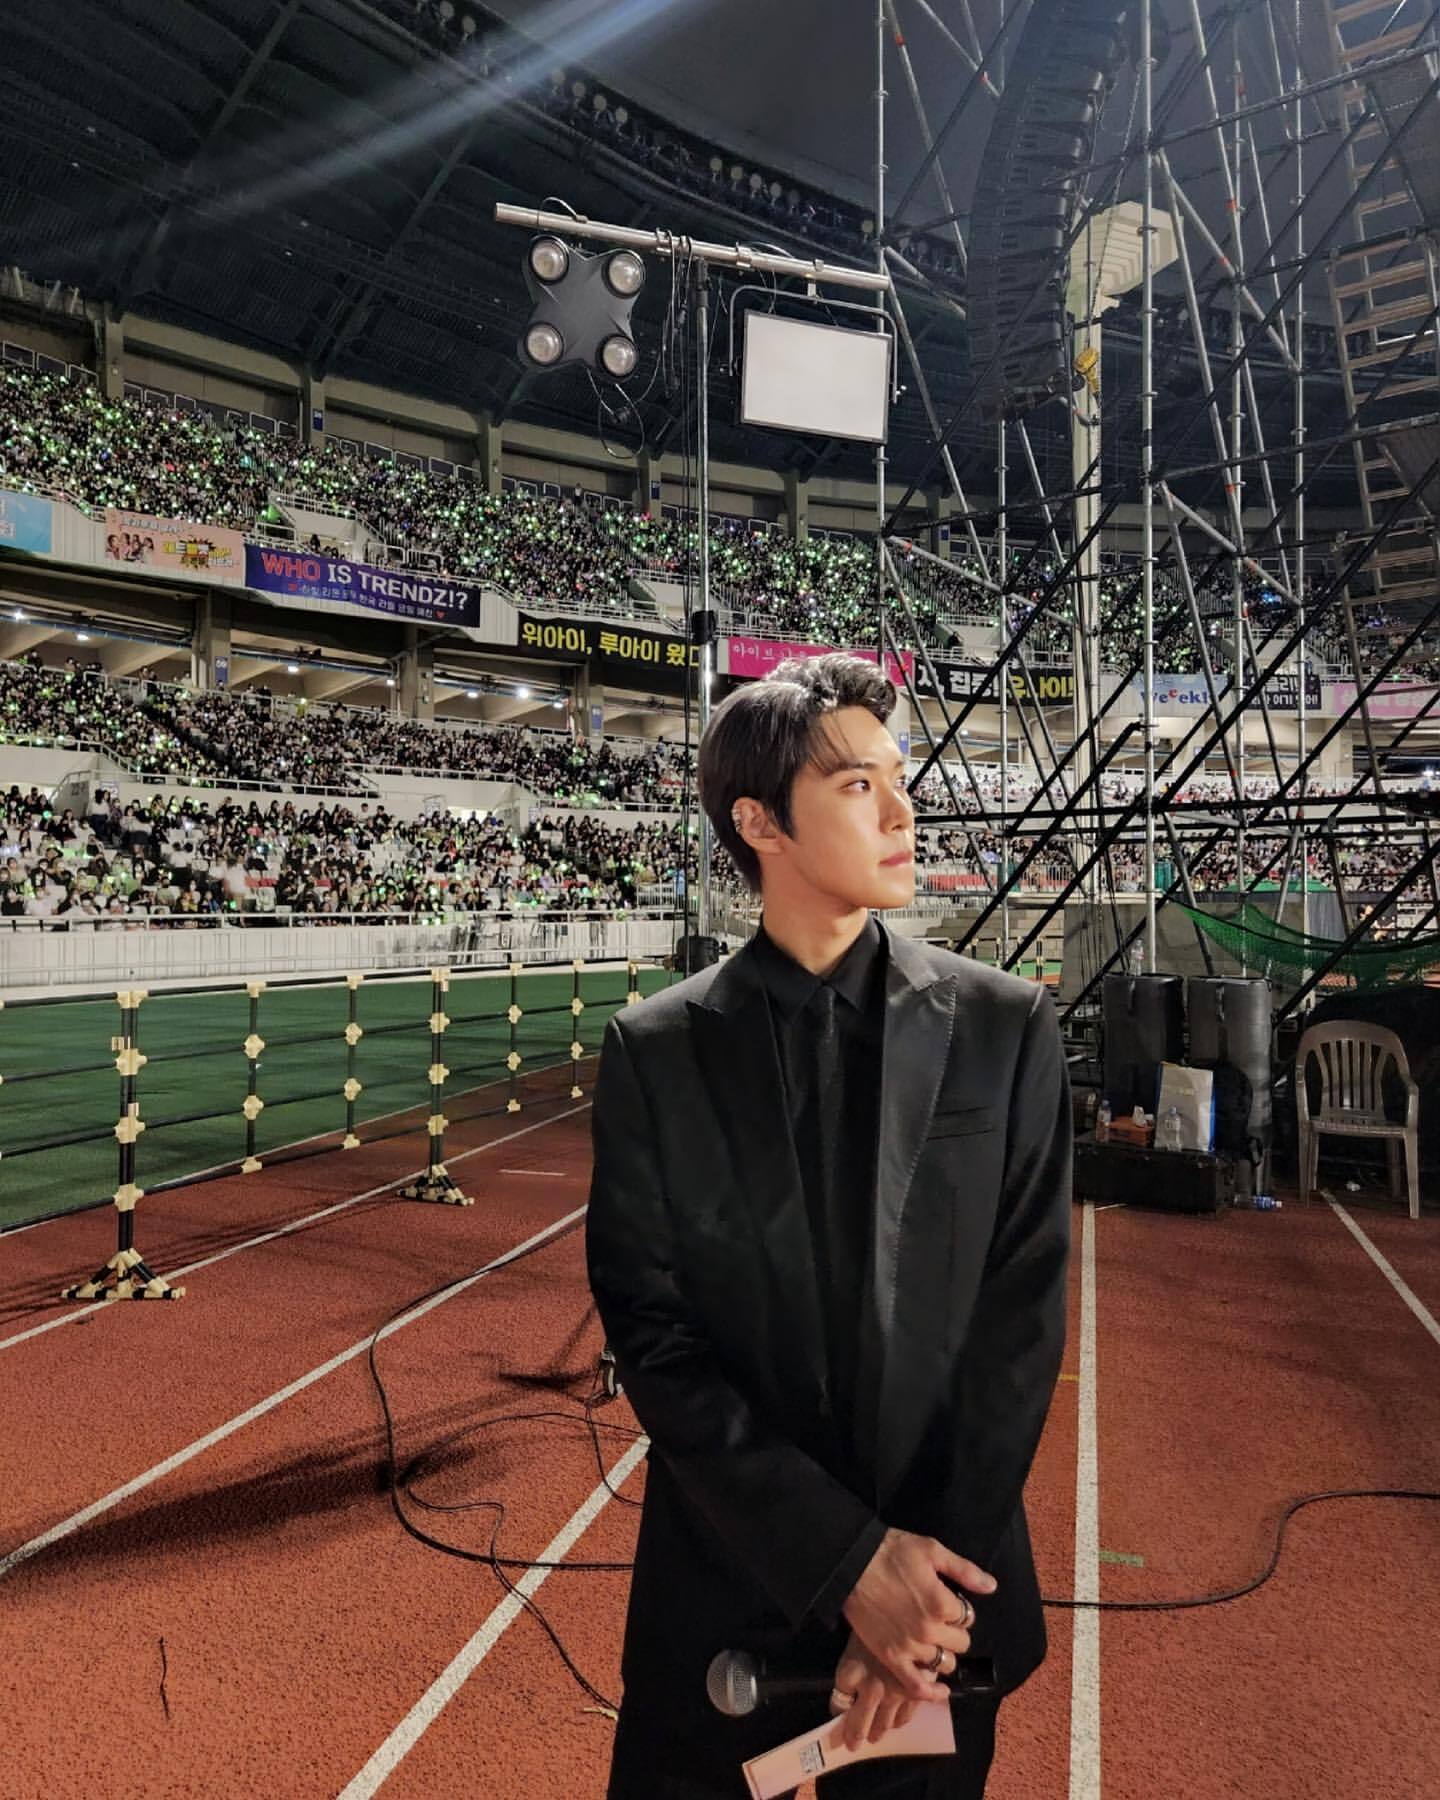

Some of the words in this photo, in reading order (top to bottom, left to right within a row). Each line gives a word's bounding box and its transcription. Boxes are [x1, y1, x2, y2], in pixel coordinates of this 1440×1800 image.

[262, 552, 320, 581] WHO
[328, 563, 352, 584] IS
[358, 570, 468, 610] TRENDZ!?
[522, 622, 592, 655] 위아이,
[599, 631, 659, 663] 루아이
[1140, 689, 1212, 704] eeekl
